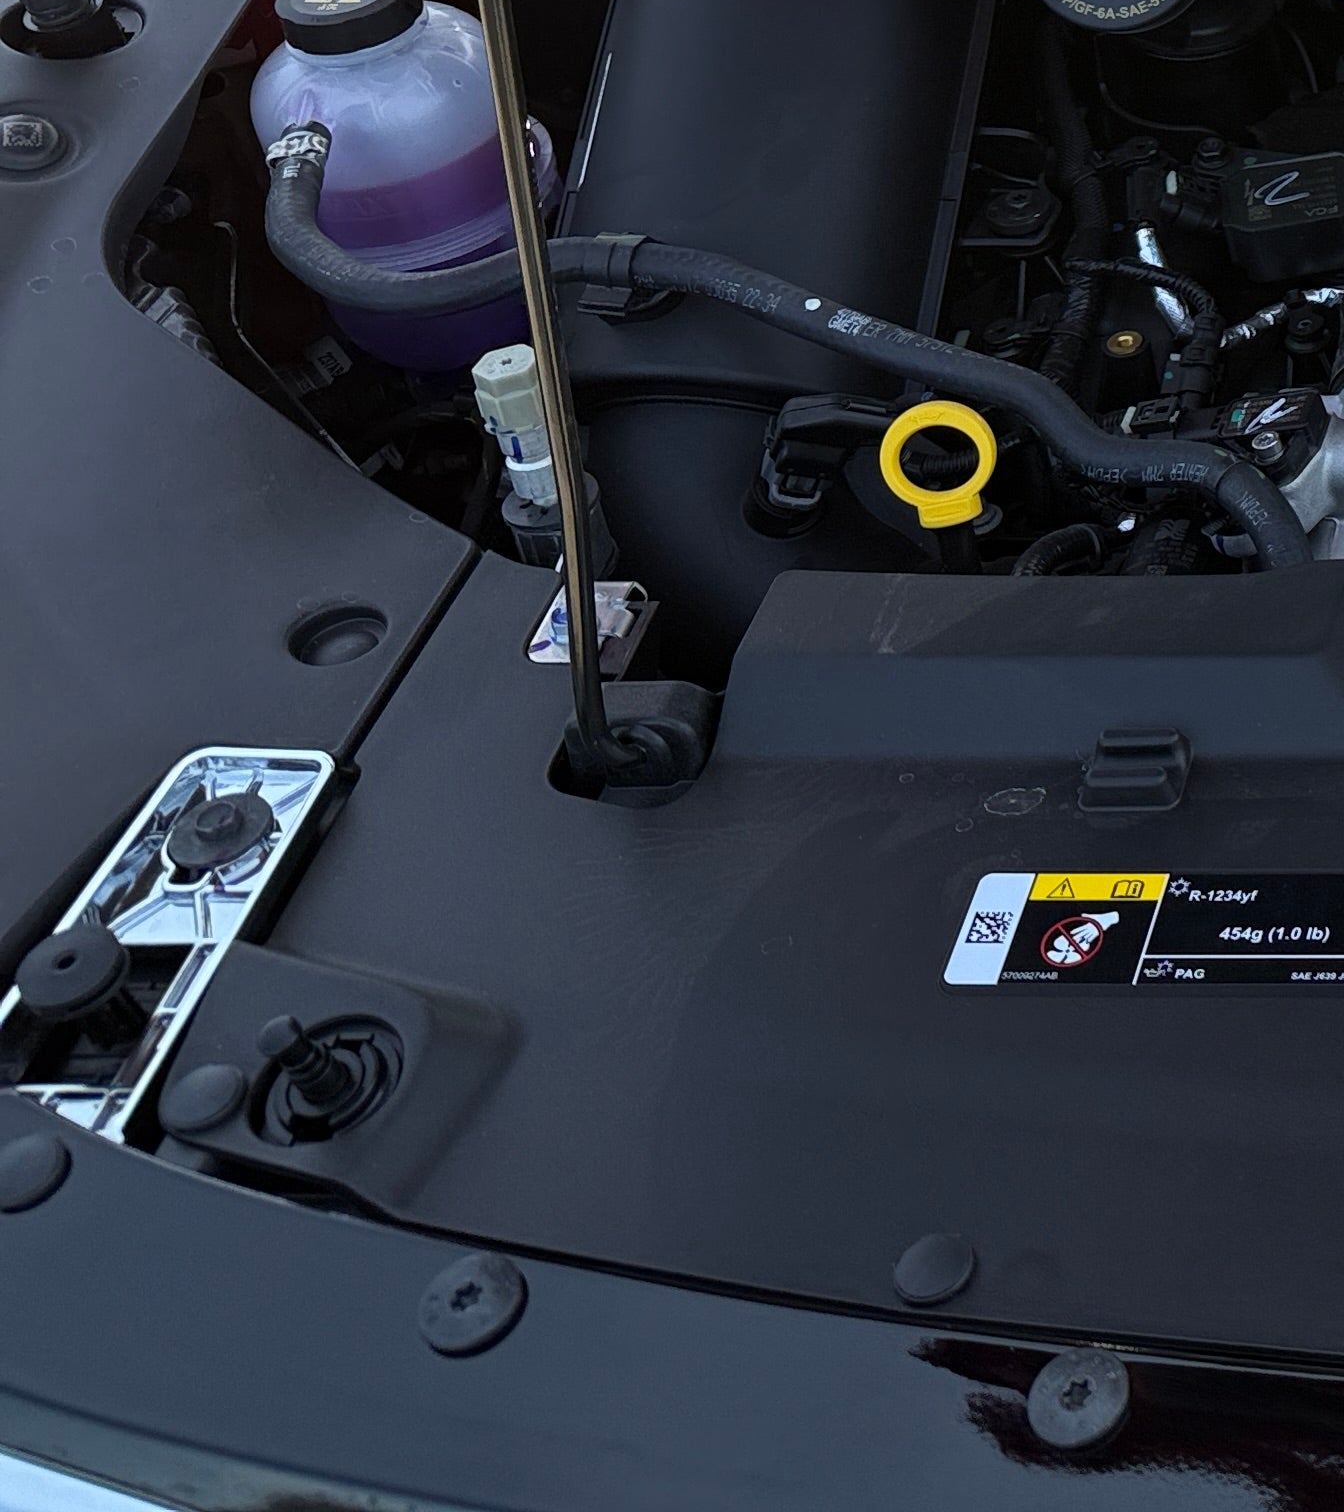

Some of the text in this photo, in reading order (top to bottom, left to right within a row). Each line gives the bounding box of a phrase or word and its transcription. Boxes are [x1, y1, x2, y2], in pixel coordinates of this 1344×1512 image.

[1188, 889, 1258, 902] R-1234yf
[1219, 926, 1330, 943] 454g (1.0 lb)
[1174, 968, 1206, 979] PAG
[1290, 971, 1312, 981] SAE
[1313, 971, 1337, 981] J639
